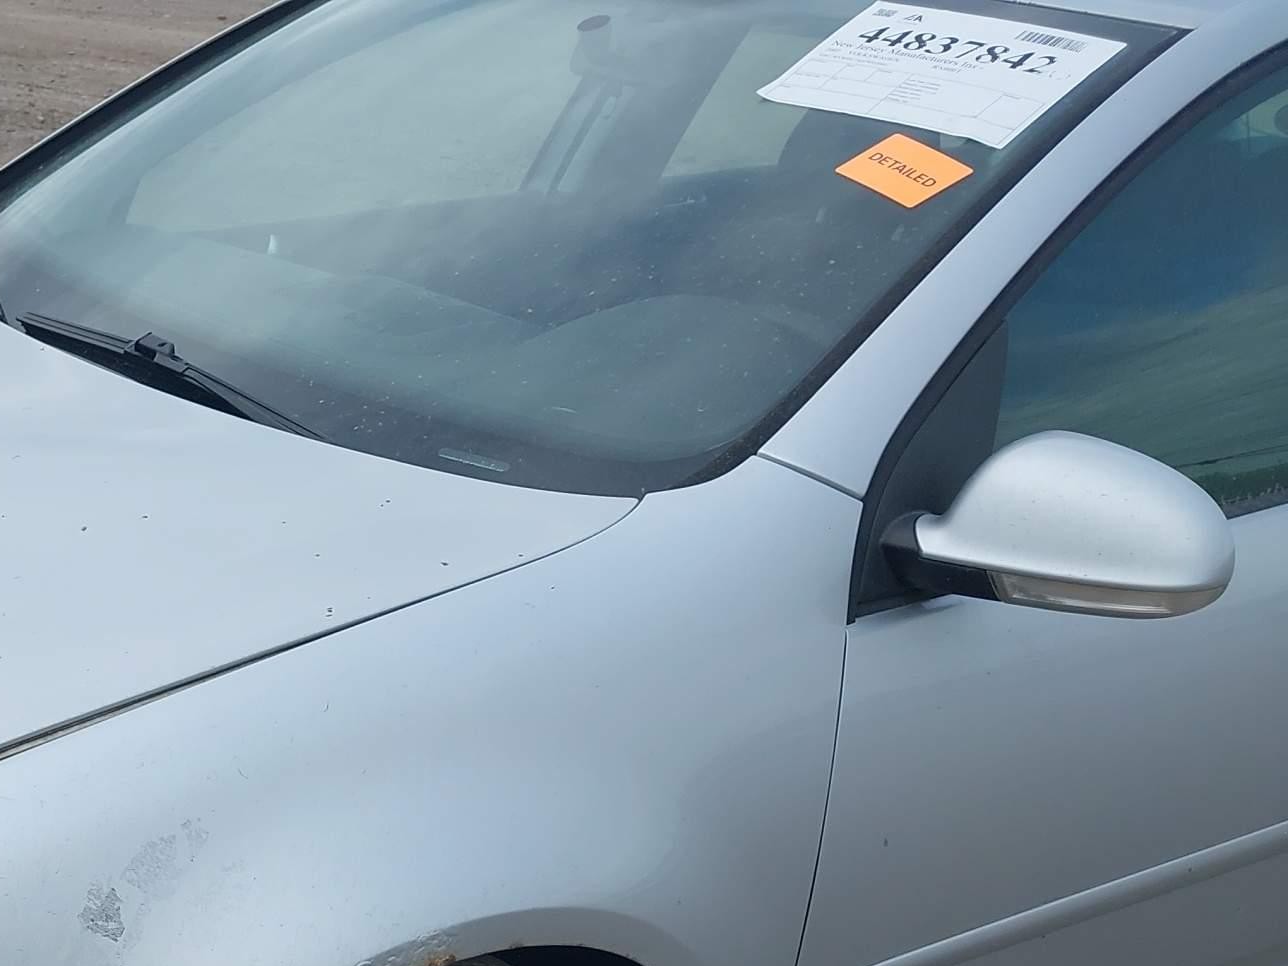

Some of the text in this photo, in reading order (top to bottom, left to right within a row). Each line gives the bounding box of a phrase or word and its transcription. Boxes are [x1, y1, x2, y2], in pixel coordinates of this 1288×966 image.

[858, 26, 1057, 73] 44837842
[888, 48, 958, 66] Manufacturers
[867, 151, 938, 188] DETAILED
